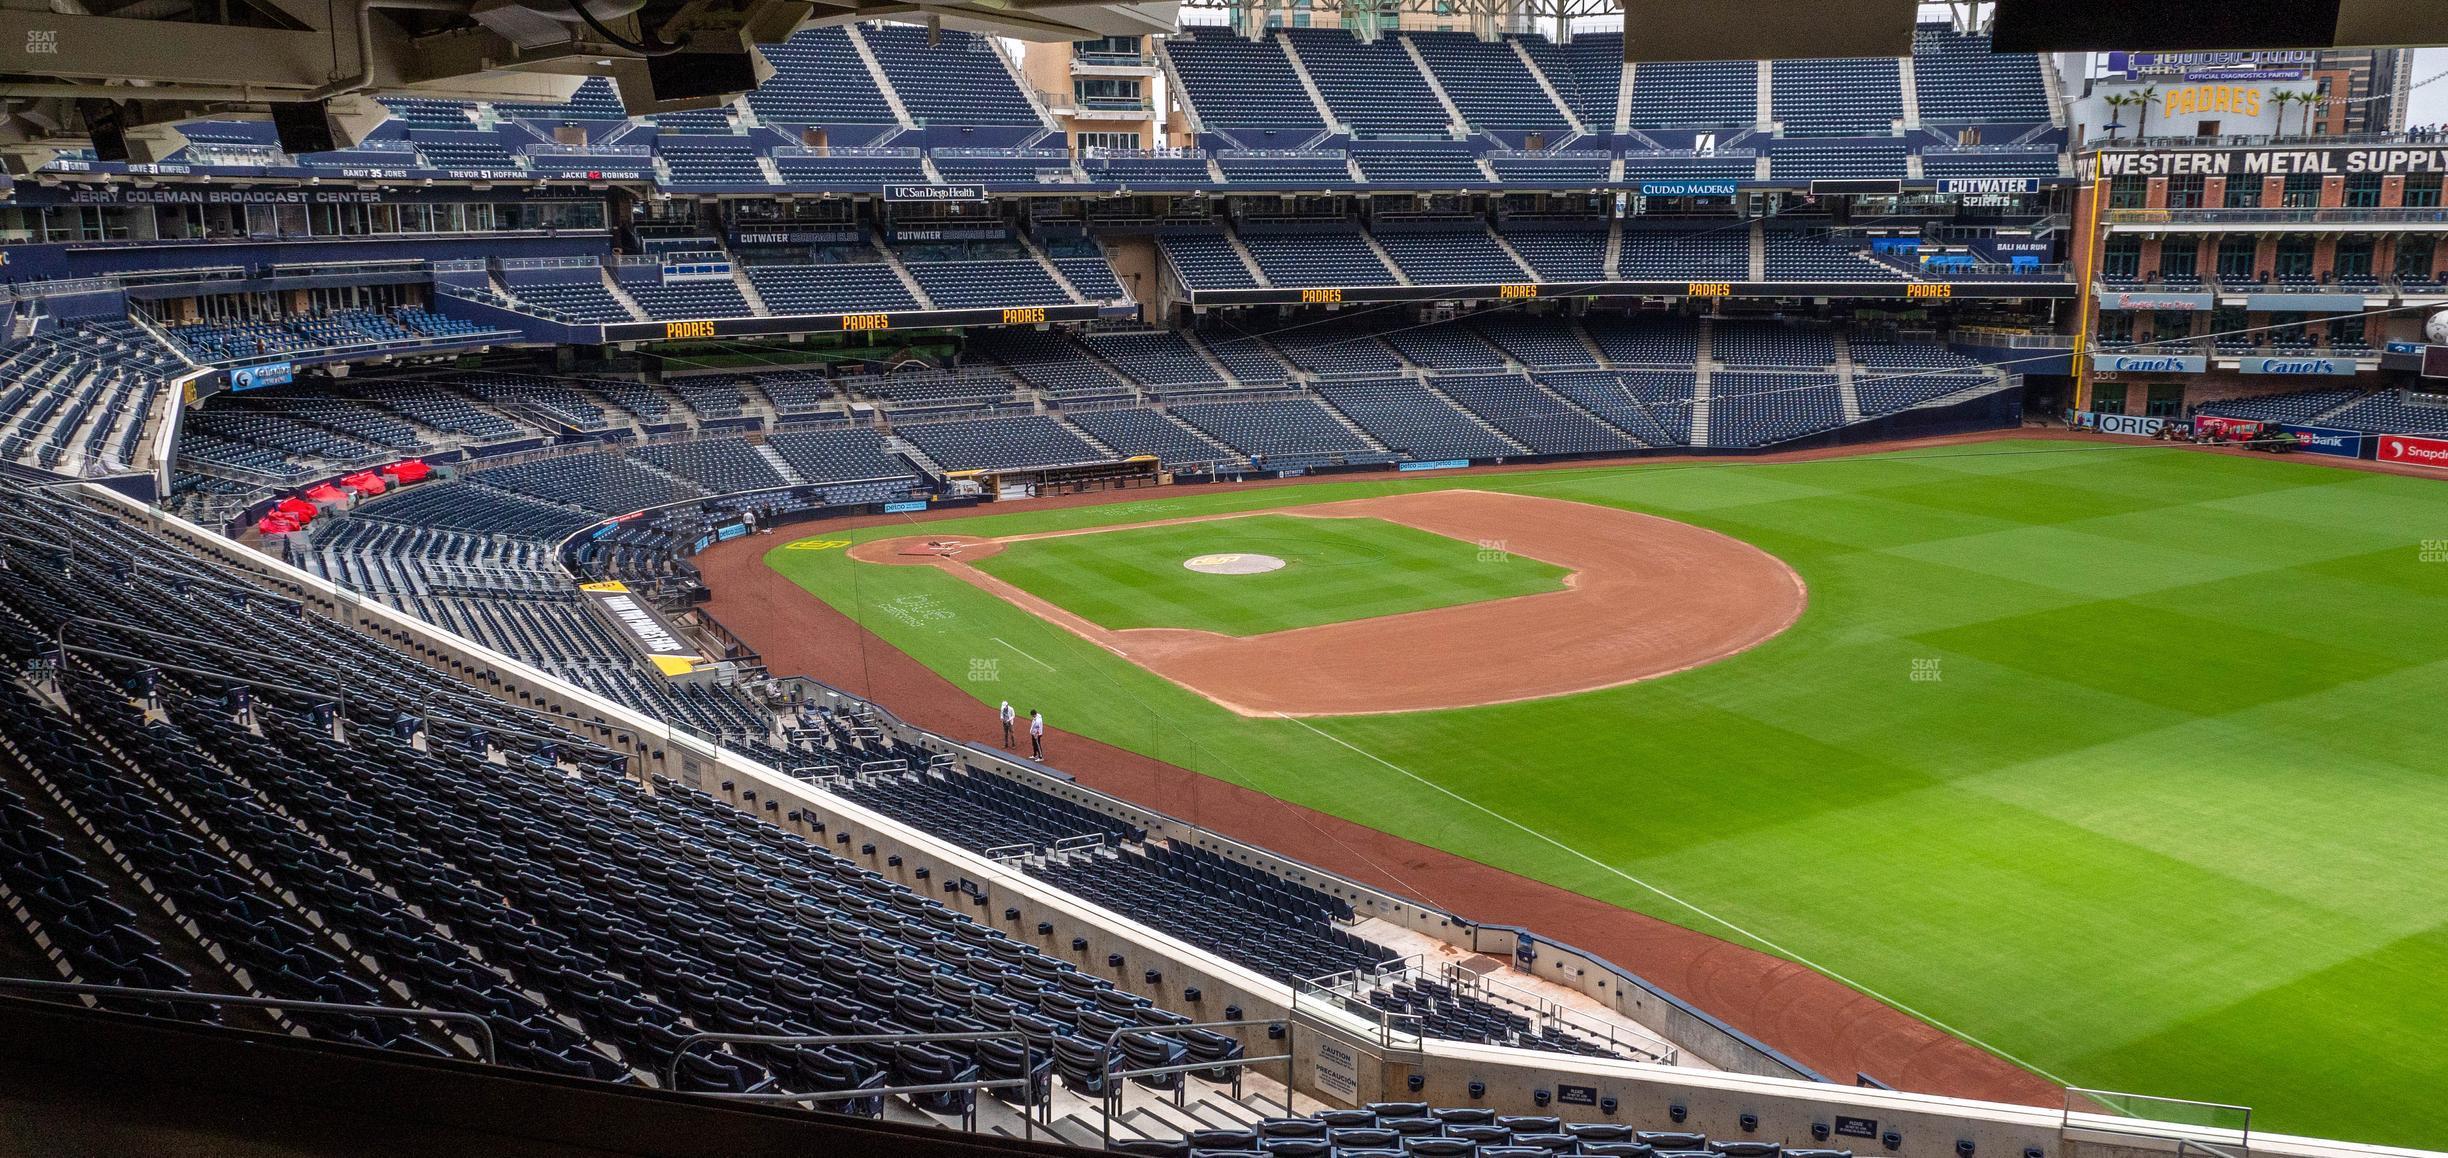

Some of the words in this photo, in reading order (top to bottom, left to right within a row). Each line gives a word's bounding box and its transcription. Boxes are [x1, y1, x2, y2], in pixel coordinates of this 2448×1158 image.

[2221, 72, 2267, 80] DIAGNOSTICS
[2268, 71, 2299, 79] PARTNER
[2164, 84, 2260, 118] PADRES
[148, 164, 159, 174] 31
[160, 166, 190, 174] WINFIELD
[2101, 153, 2231, 175] WESTERN
[2243, 151, 2337, 175] METAL
[343, 169, 369, 177] RANDY
[370, 169, 382, 178] 35
[384, 170, 407, 178] JONES
[449, 170, 479, 179] TREVOR
[481, 170, 491, 179] 51
[493, 171, 528, 179] HOFFMAN
[561, 171, 587, 179] JACKIE
[588, 171, 600, 180] 42
[602, 171, 640, 180] ROBINSON
[1643, 184, 1684, 194] CIUDAD
[1687, 184, 1735, 194] MADERAS
[1948, 179, 2027, 193] CUTWATER
[71, 191, 119, 203] JERRY
[126, 191, 203, 203] COLEMAN
[209, 191, 309, 204] BROADCAST
[316, 192, 381, 203] CENTER
[895, 187, 909, 198] UC
[909, 187, 925, 198] San
[925, 187, 948, 200] Diego
[949, 187, 975, 198] Health
[1962, 195, 2011, 207] SPIRITS
[741, 233, 789, 243] CUTWATER
[897, 231, 941, 241] CUTWATER
[2016, 243, 2029, 251] HAI
[2030, 243, 2047, 251] RUM
[1302, 289, 1341, 303] PADRES
[1500, 284, 1537, 298] PADRES
[1688, 282, 1730, 296] PADRES
[1907, 284, 1951, 297] PADRES
[842, 314, 888, 330] PADRES
[1003, 308, 1045, 323] PADRES
[666, 321, 714, 338] PADRES
[2115, 357, 2184, 371] Canel's
[2261, 359, 2334, 374] Canel's
[2103, 416, 2160, 434] ORIS
[2312, 433, 2343, 447] bank
[1322, 1045, 1351, 1062] CAUTION
